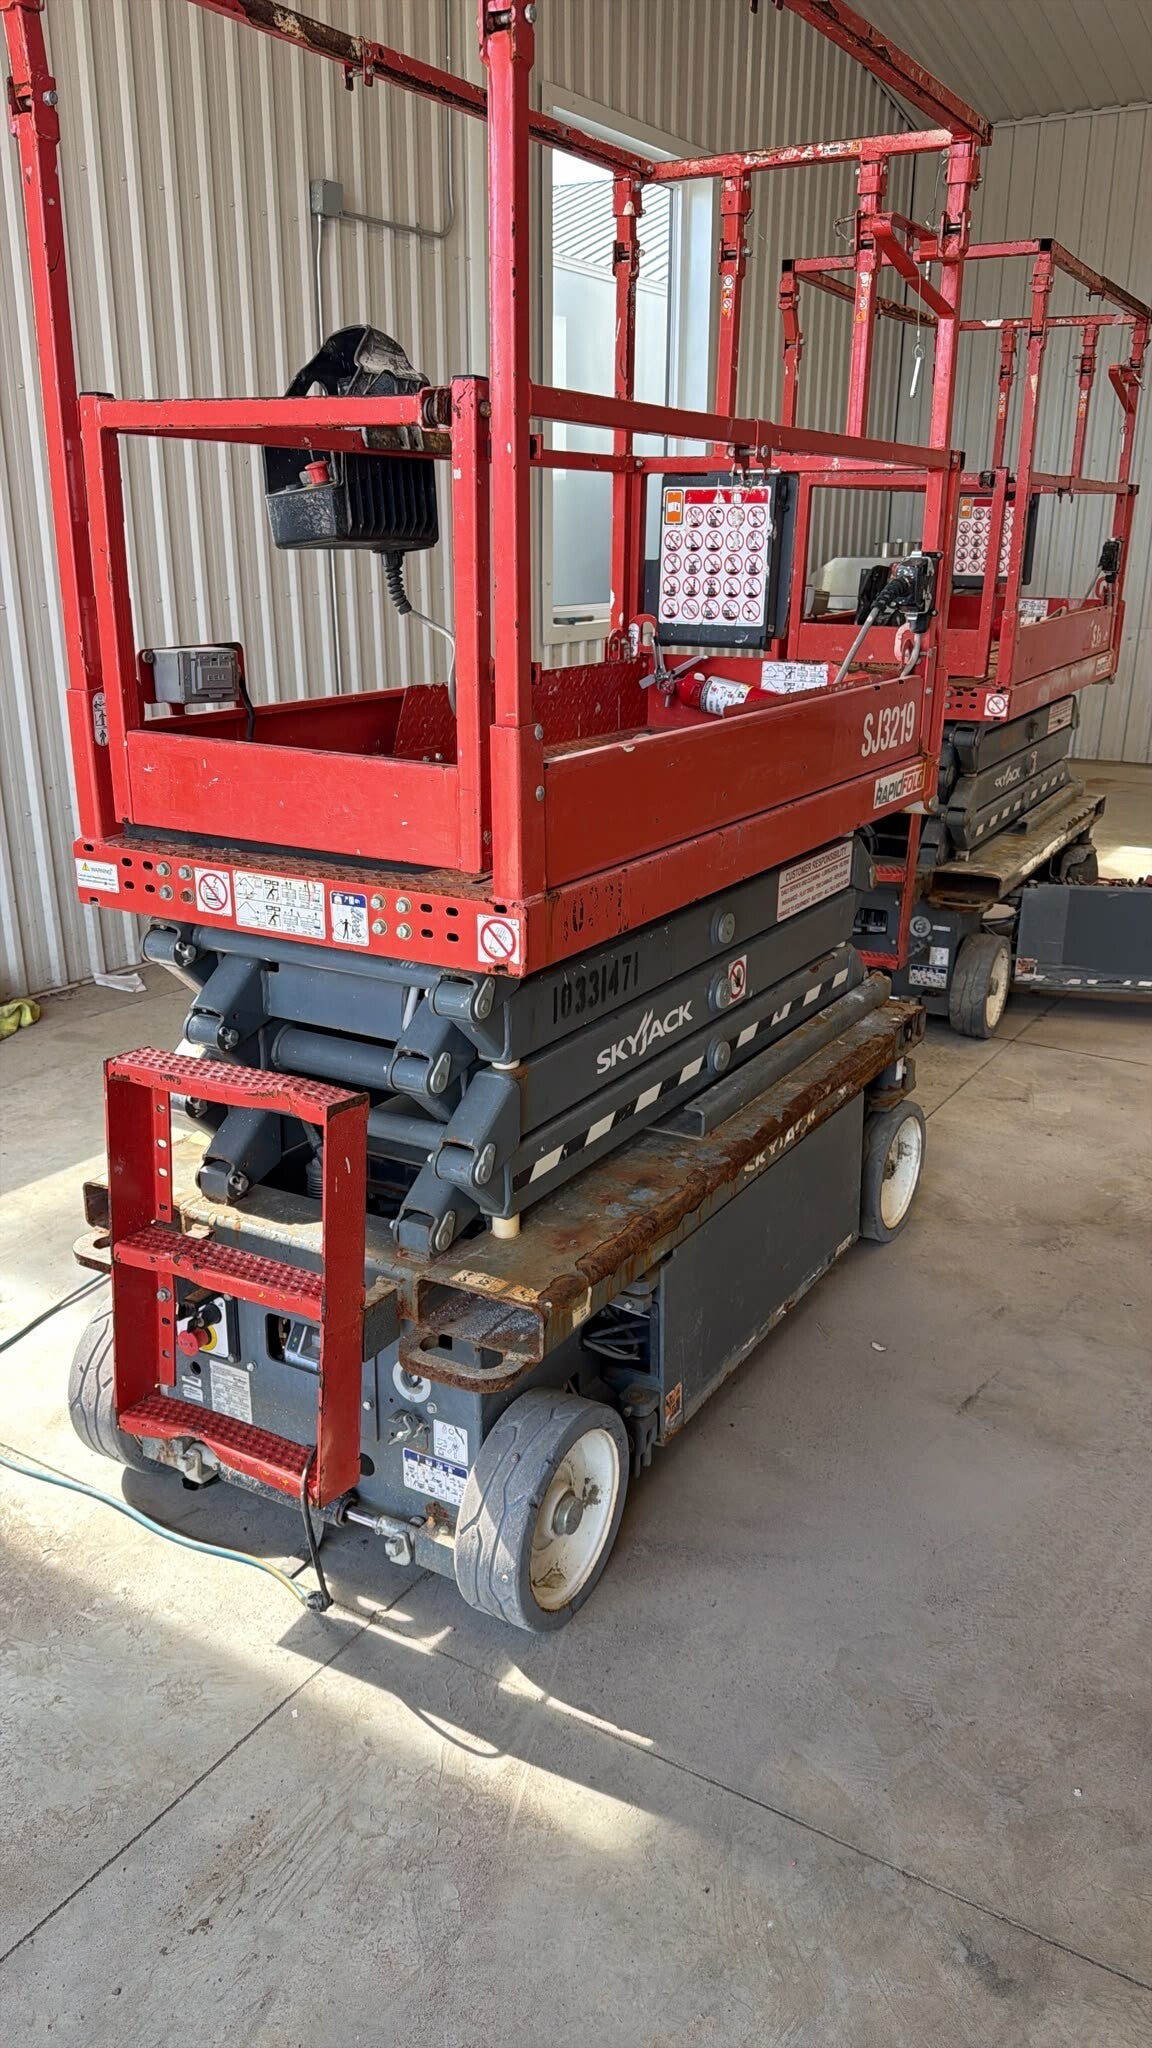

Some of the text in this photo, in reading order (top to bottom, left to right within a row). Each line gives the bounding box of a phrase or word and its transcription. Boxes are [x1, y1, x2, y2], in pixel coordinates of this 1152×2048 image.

[861, 701, 916, 758] SJ3219
[785, 847, 847, 881] CUSTOMER RESPONSIBILITY
[553, 951, 639, 1024] 10331471
[596, 1000, 694, 1074] SKYJACK
